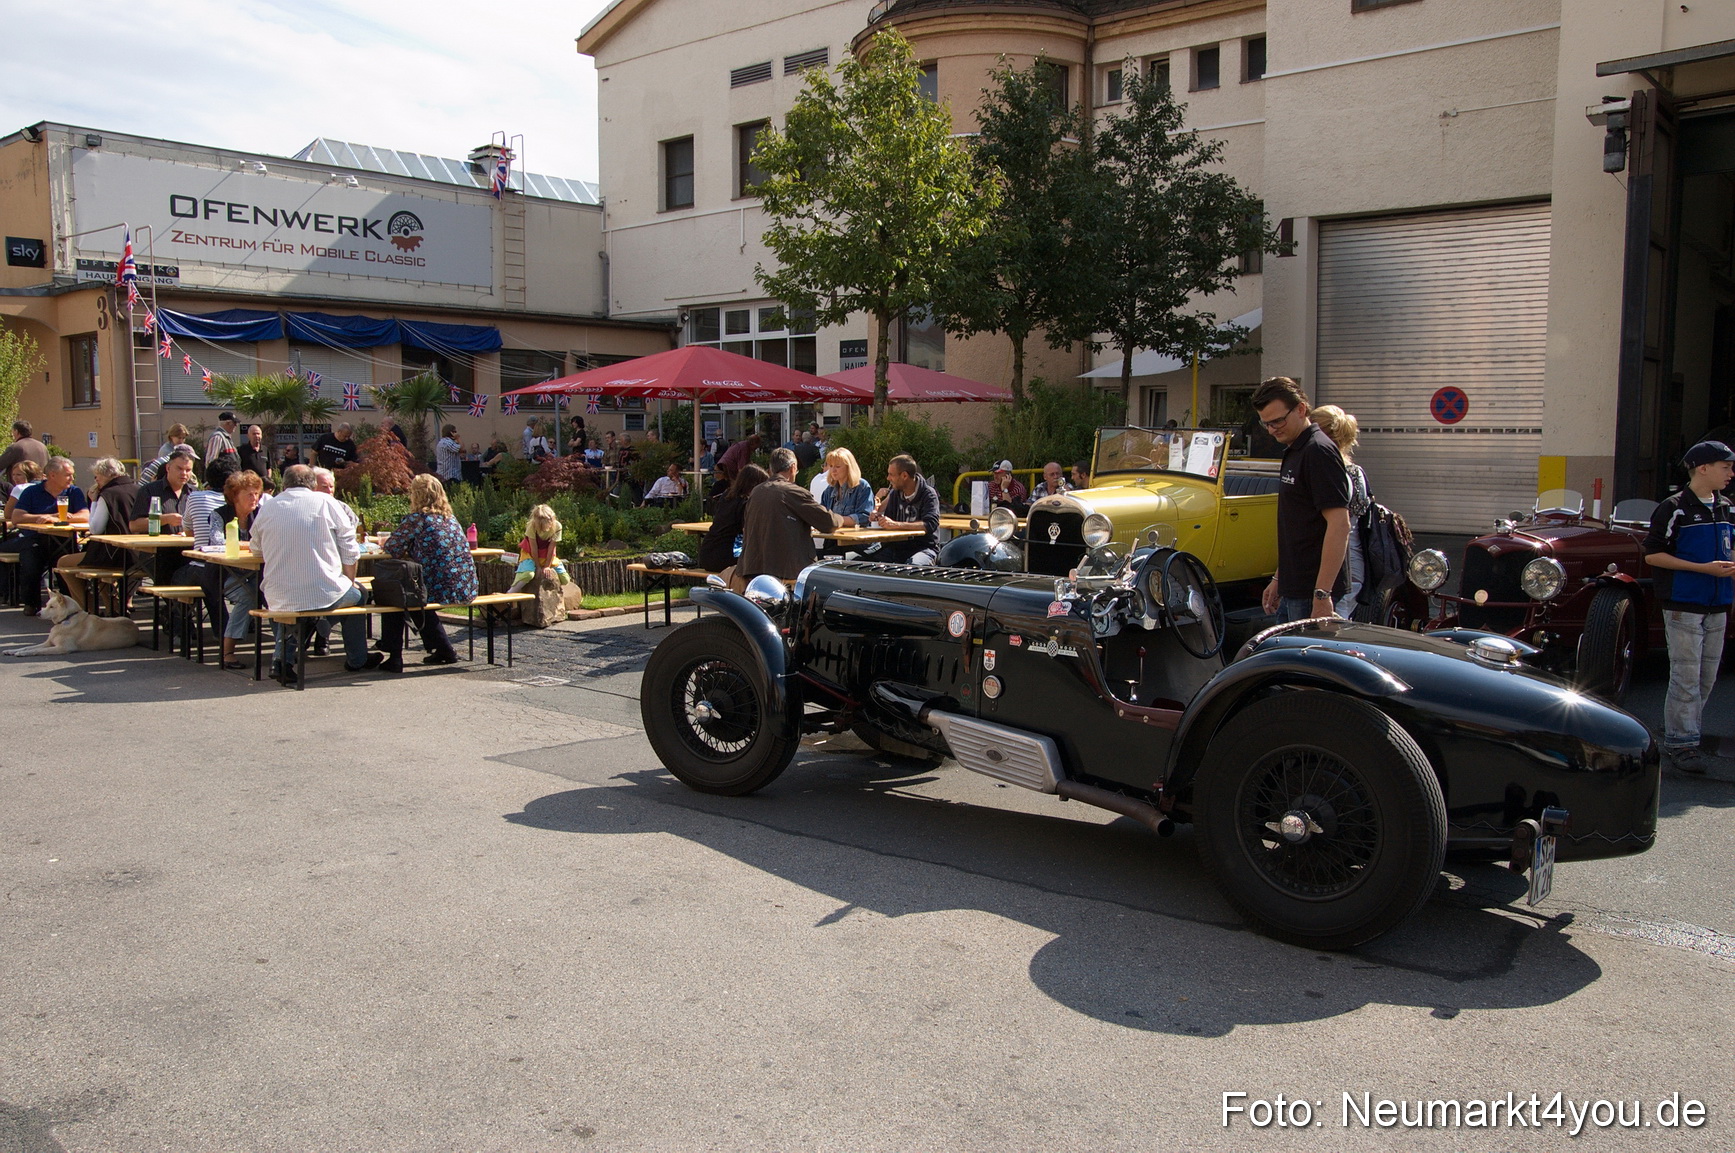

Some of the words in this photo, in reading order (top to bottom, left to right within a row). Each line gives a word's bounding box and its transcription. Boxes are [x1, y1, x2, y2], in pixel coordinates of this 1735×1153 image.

[169, 194, 385, 241] OFENWERK
[12, 243, 40, 261] sky
[170, 229, 257, 252] ZENTRUM
[300, 243, 360, 261] MOBILE
[364, 250, 426, 268] CLASSIC
[96, 295, 109, 330] 3
